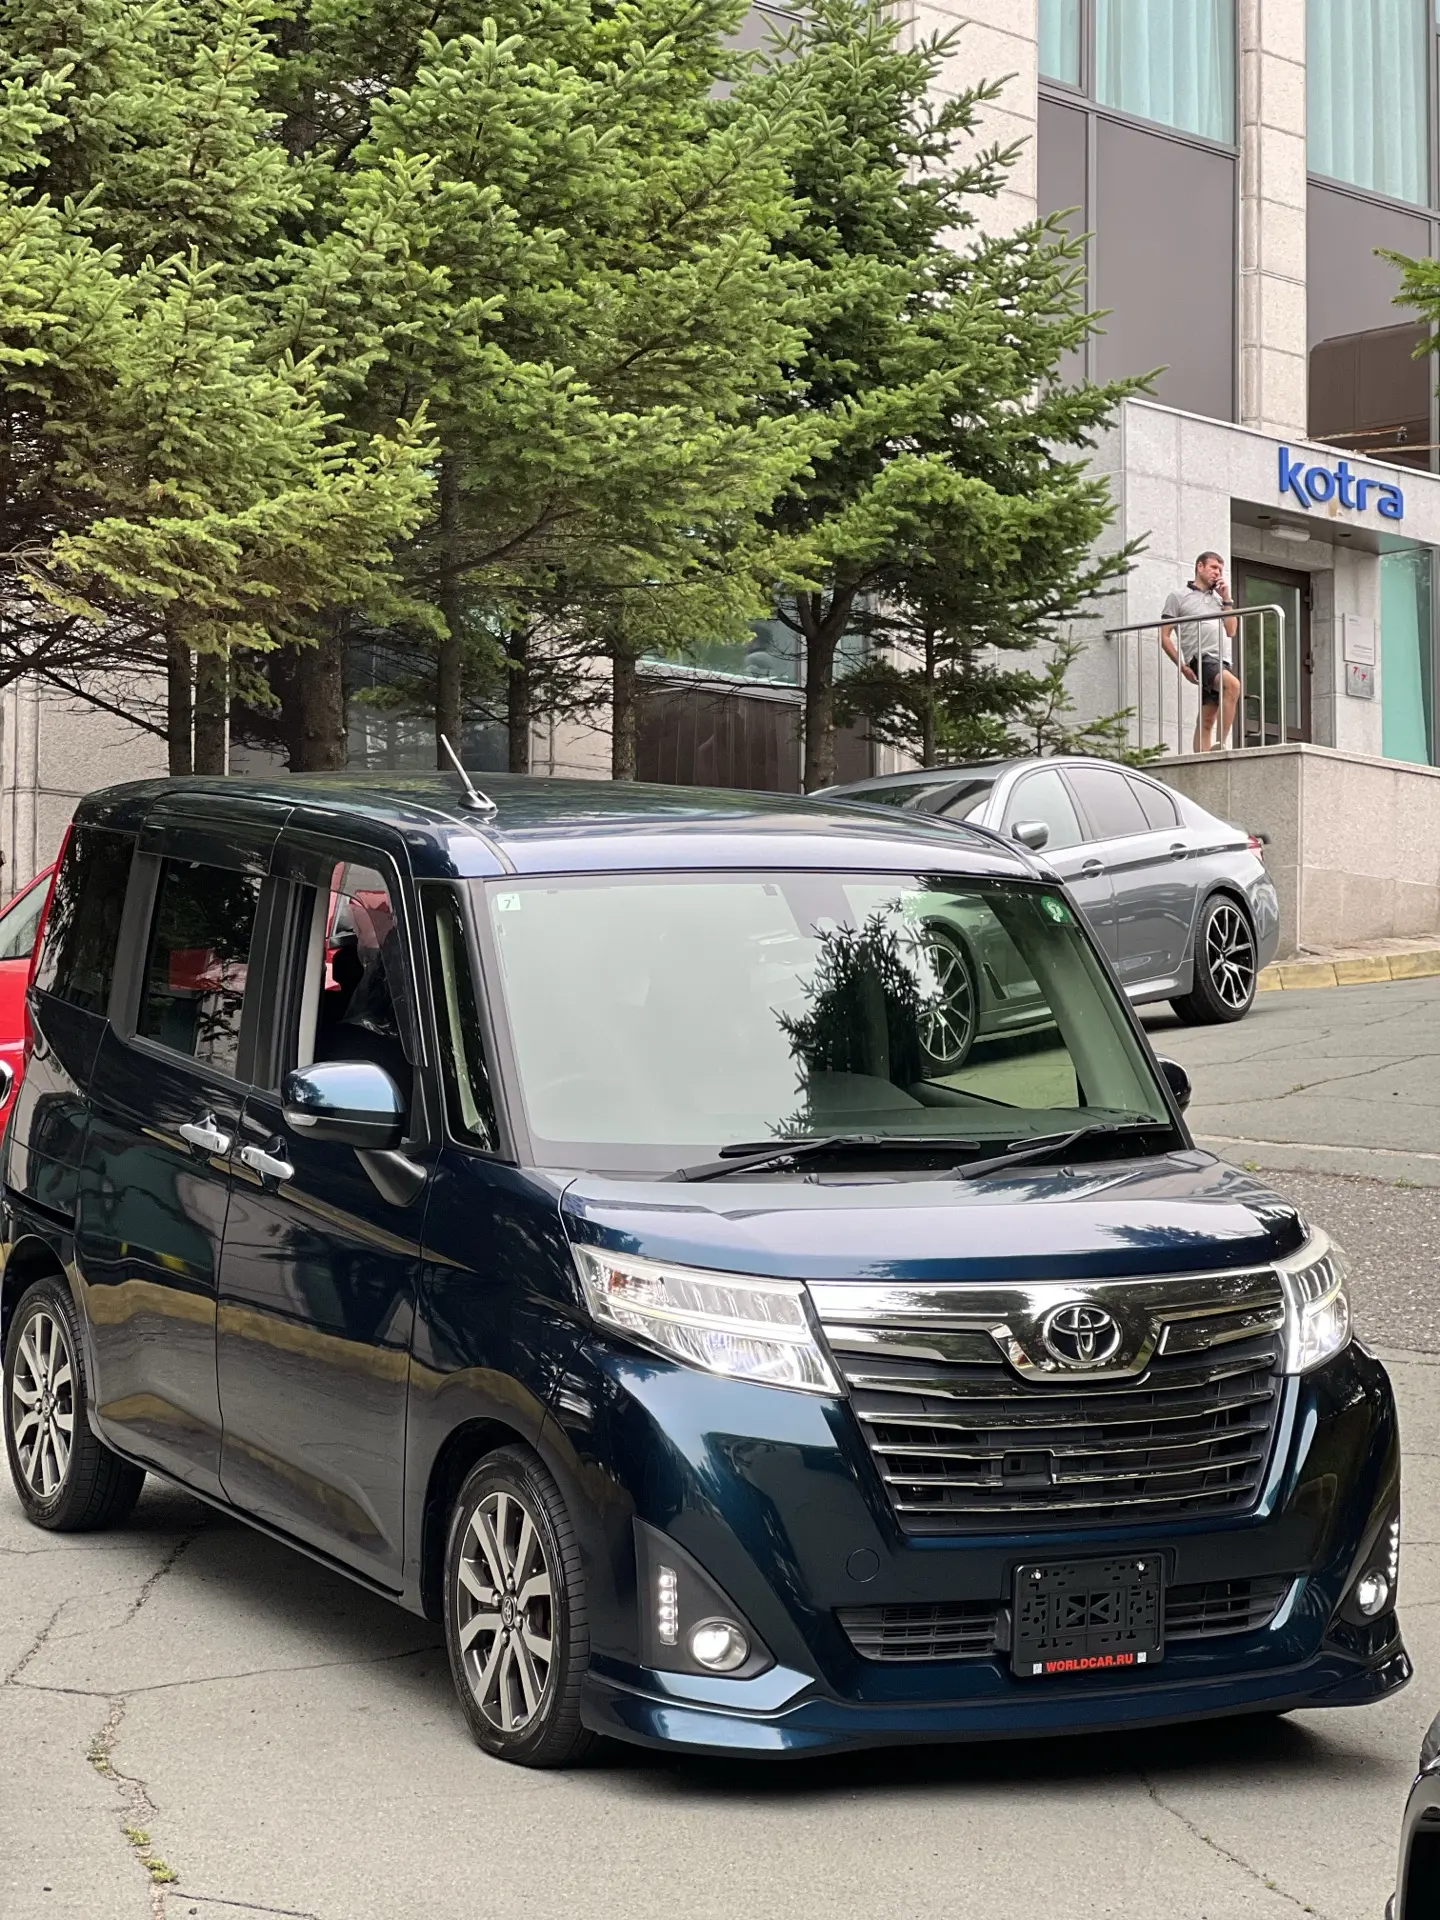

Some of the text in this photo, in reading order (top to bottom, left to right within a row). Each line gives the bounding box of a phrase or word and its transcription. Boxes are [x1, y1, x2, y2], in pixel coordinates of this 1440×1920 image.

[1278, 446, 1404, 520] kotra
[503, 899, 511, 909] 7
[1046, 1653, 1134, 1672] WORLDCAR.RU
